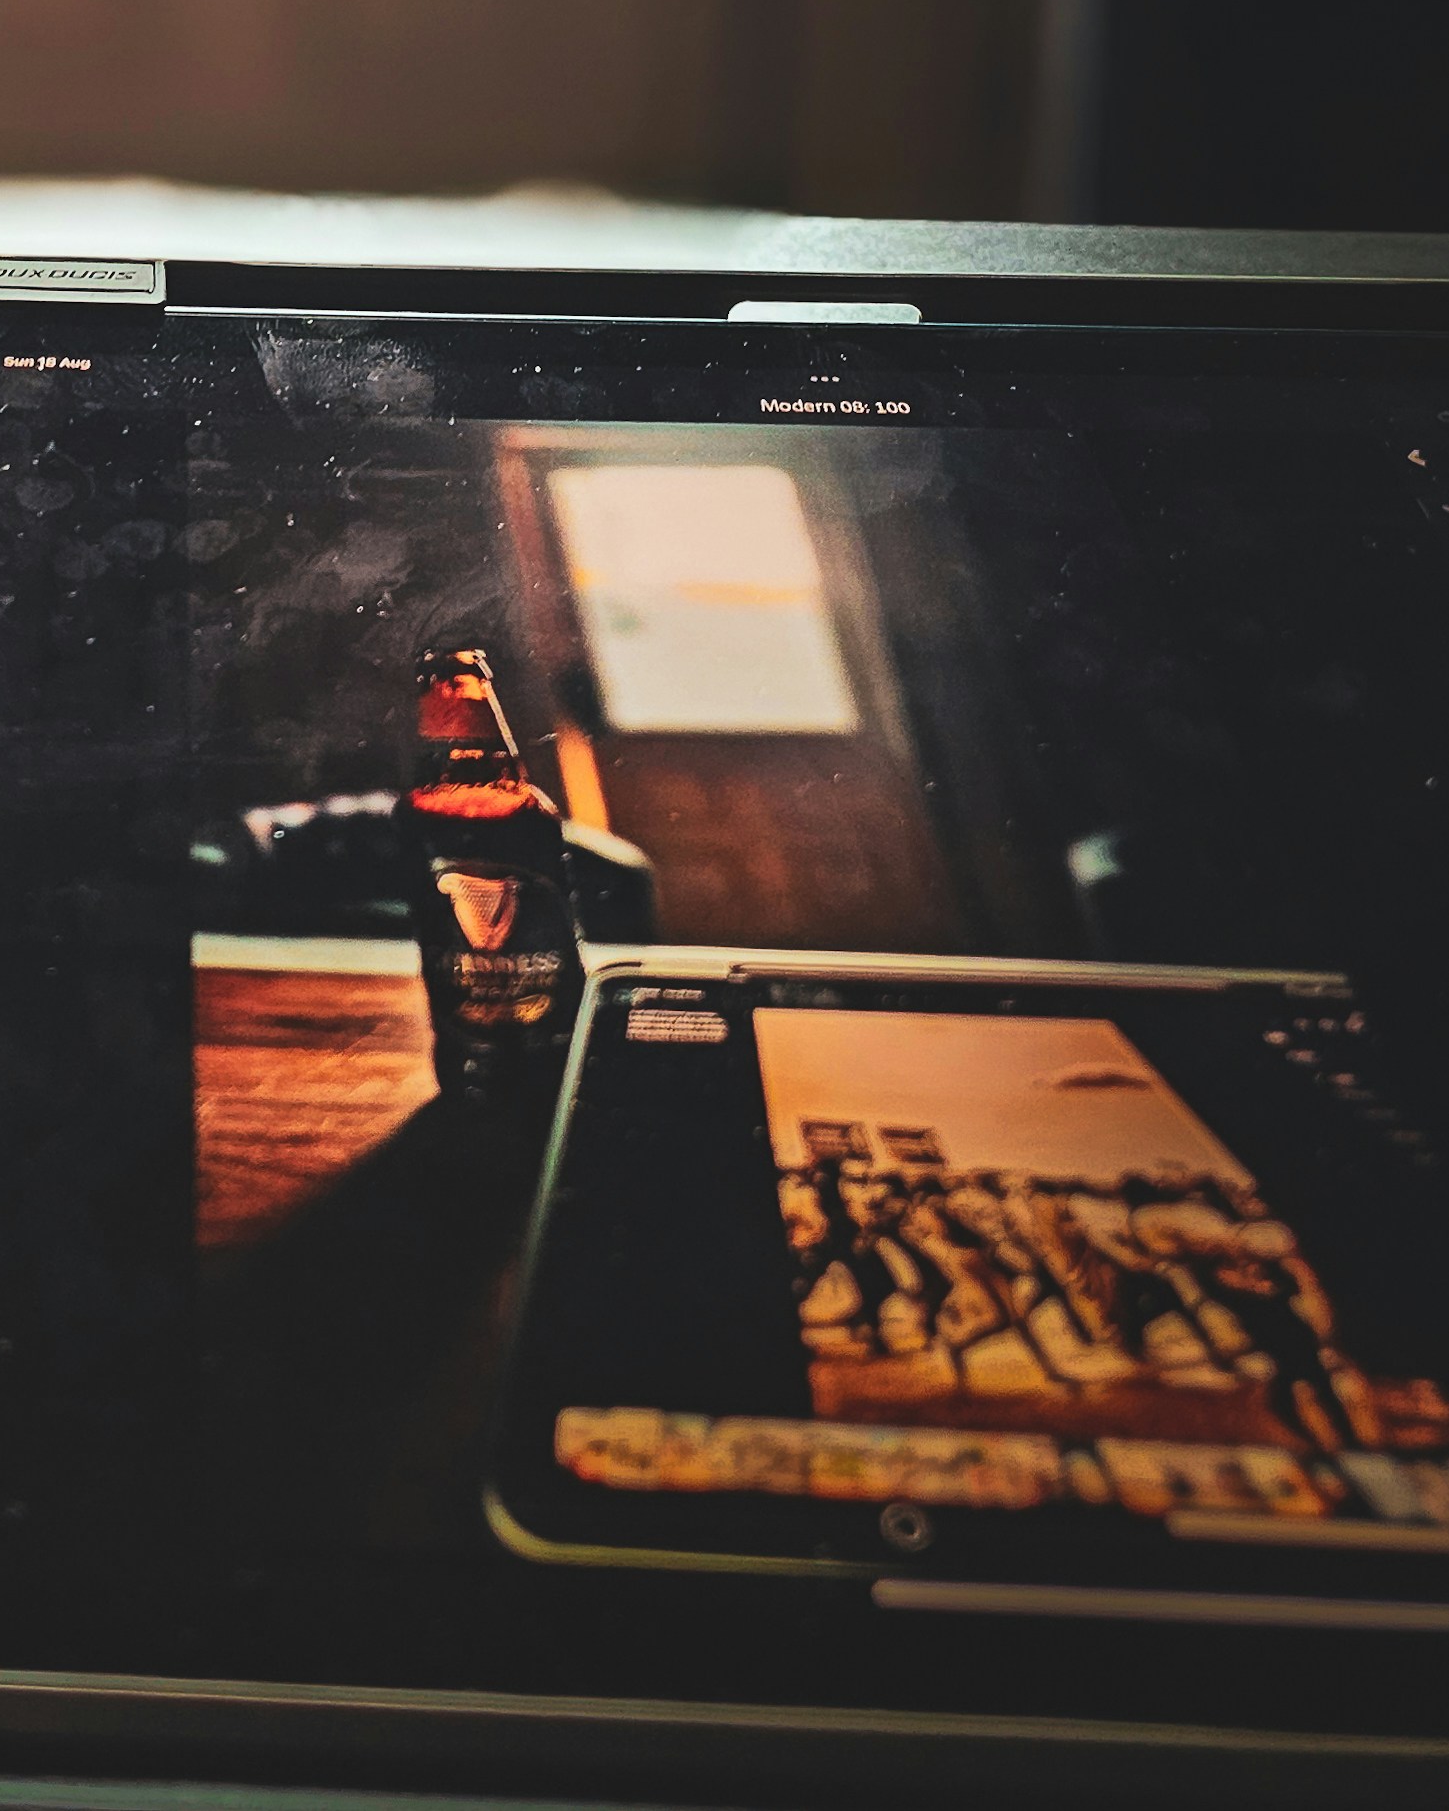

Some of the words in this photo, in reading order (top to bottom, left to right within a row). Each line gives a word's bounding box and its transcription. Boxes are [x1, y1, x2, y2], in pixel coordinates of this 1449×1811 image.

[3, 356, 35, 367] Sun
[59, 357, 92, 371] Aug
[760, 398, 836, 414] Modern
[875, 401, 911, 415] 100
